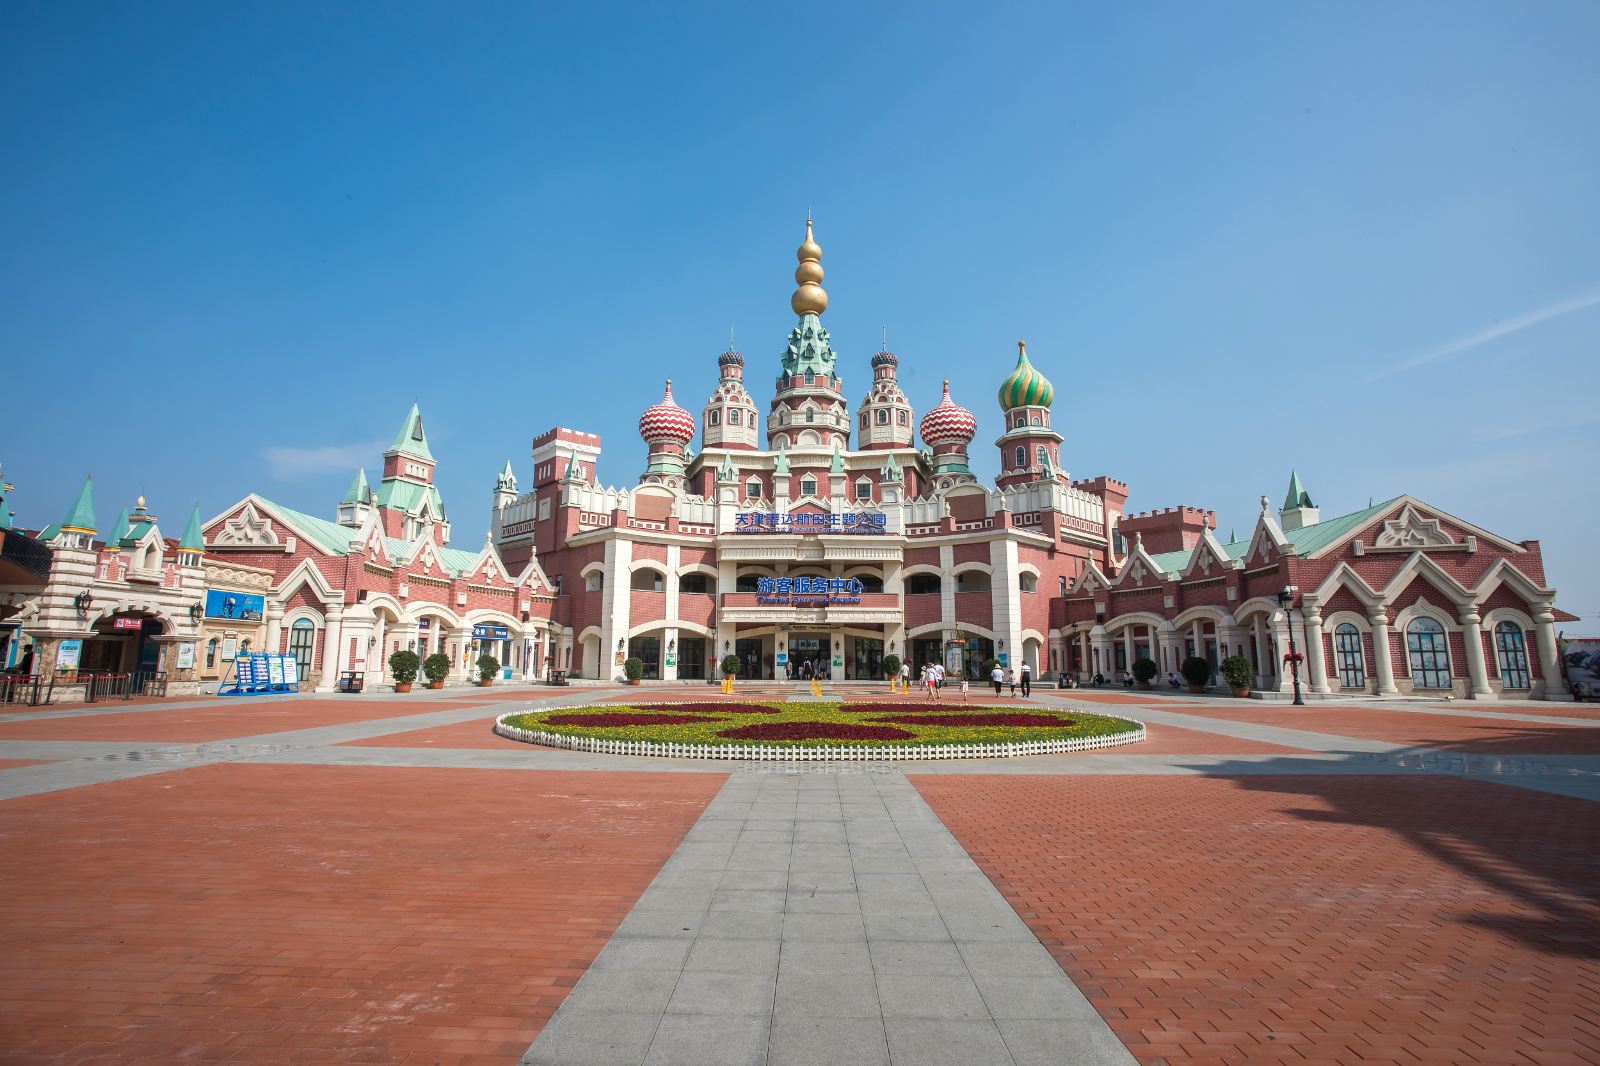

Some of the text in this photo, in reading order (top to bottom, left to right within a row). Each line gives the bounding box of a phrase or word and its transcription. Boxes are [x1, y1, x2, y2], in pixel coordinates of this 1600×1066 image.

[735, 513, 887, 526] 天津泰达航母主题公园
[757, 576, 864, 594] 游客服务中心
[475, 628, 486, 636] 公安
